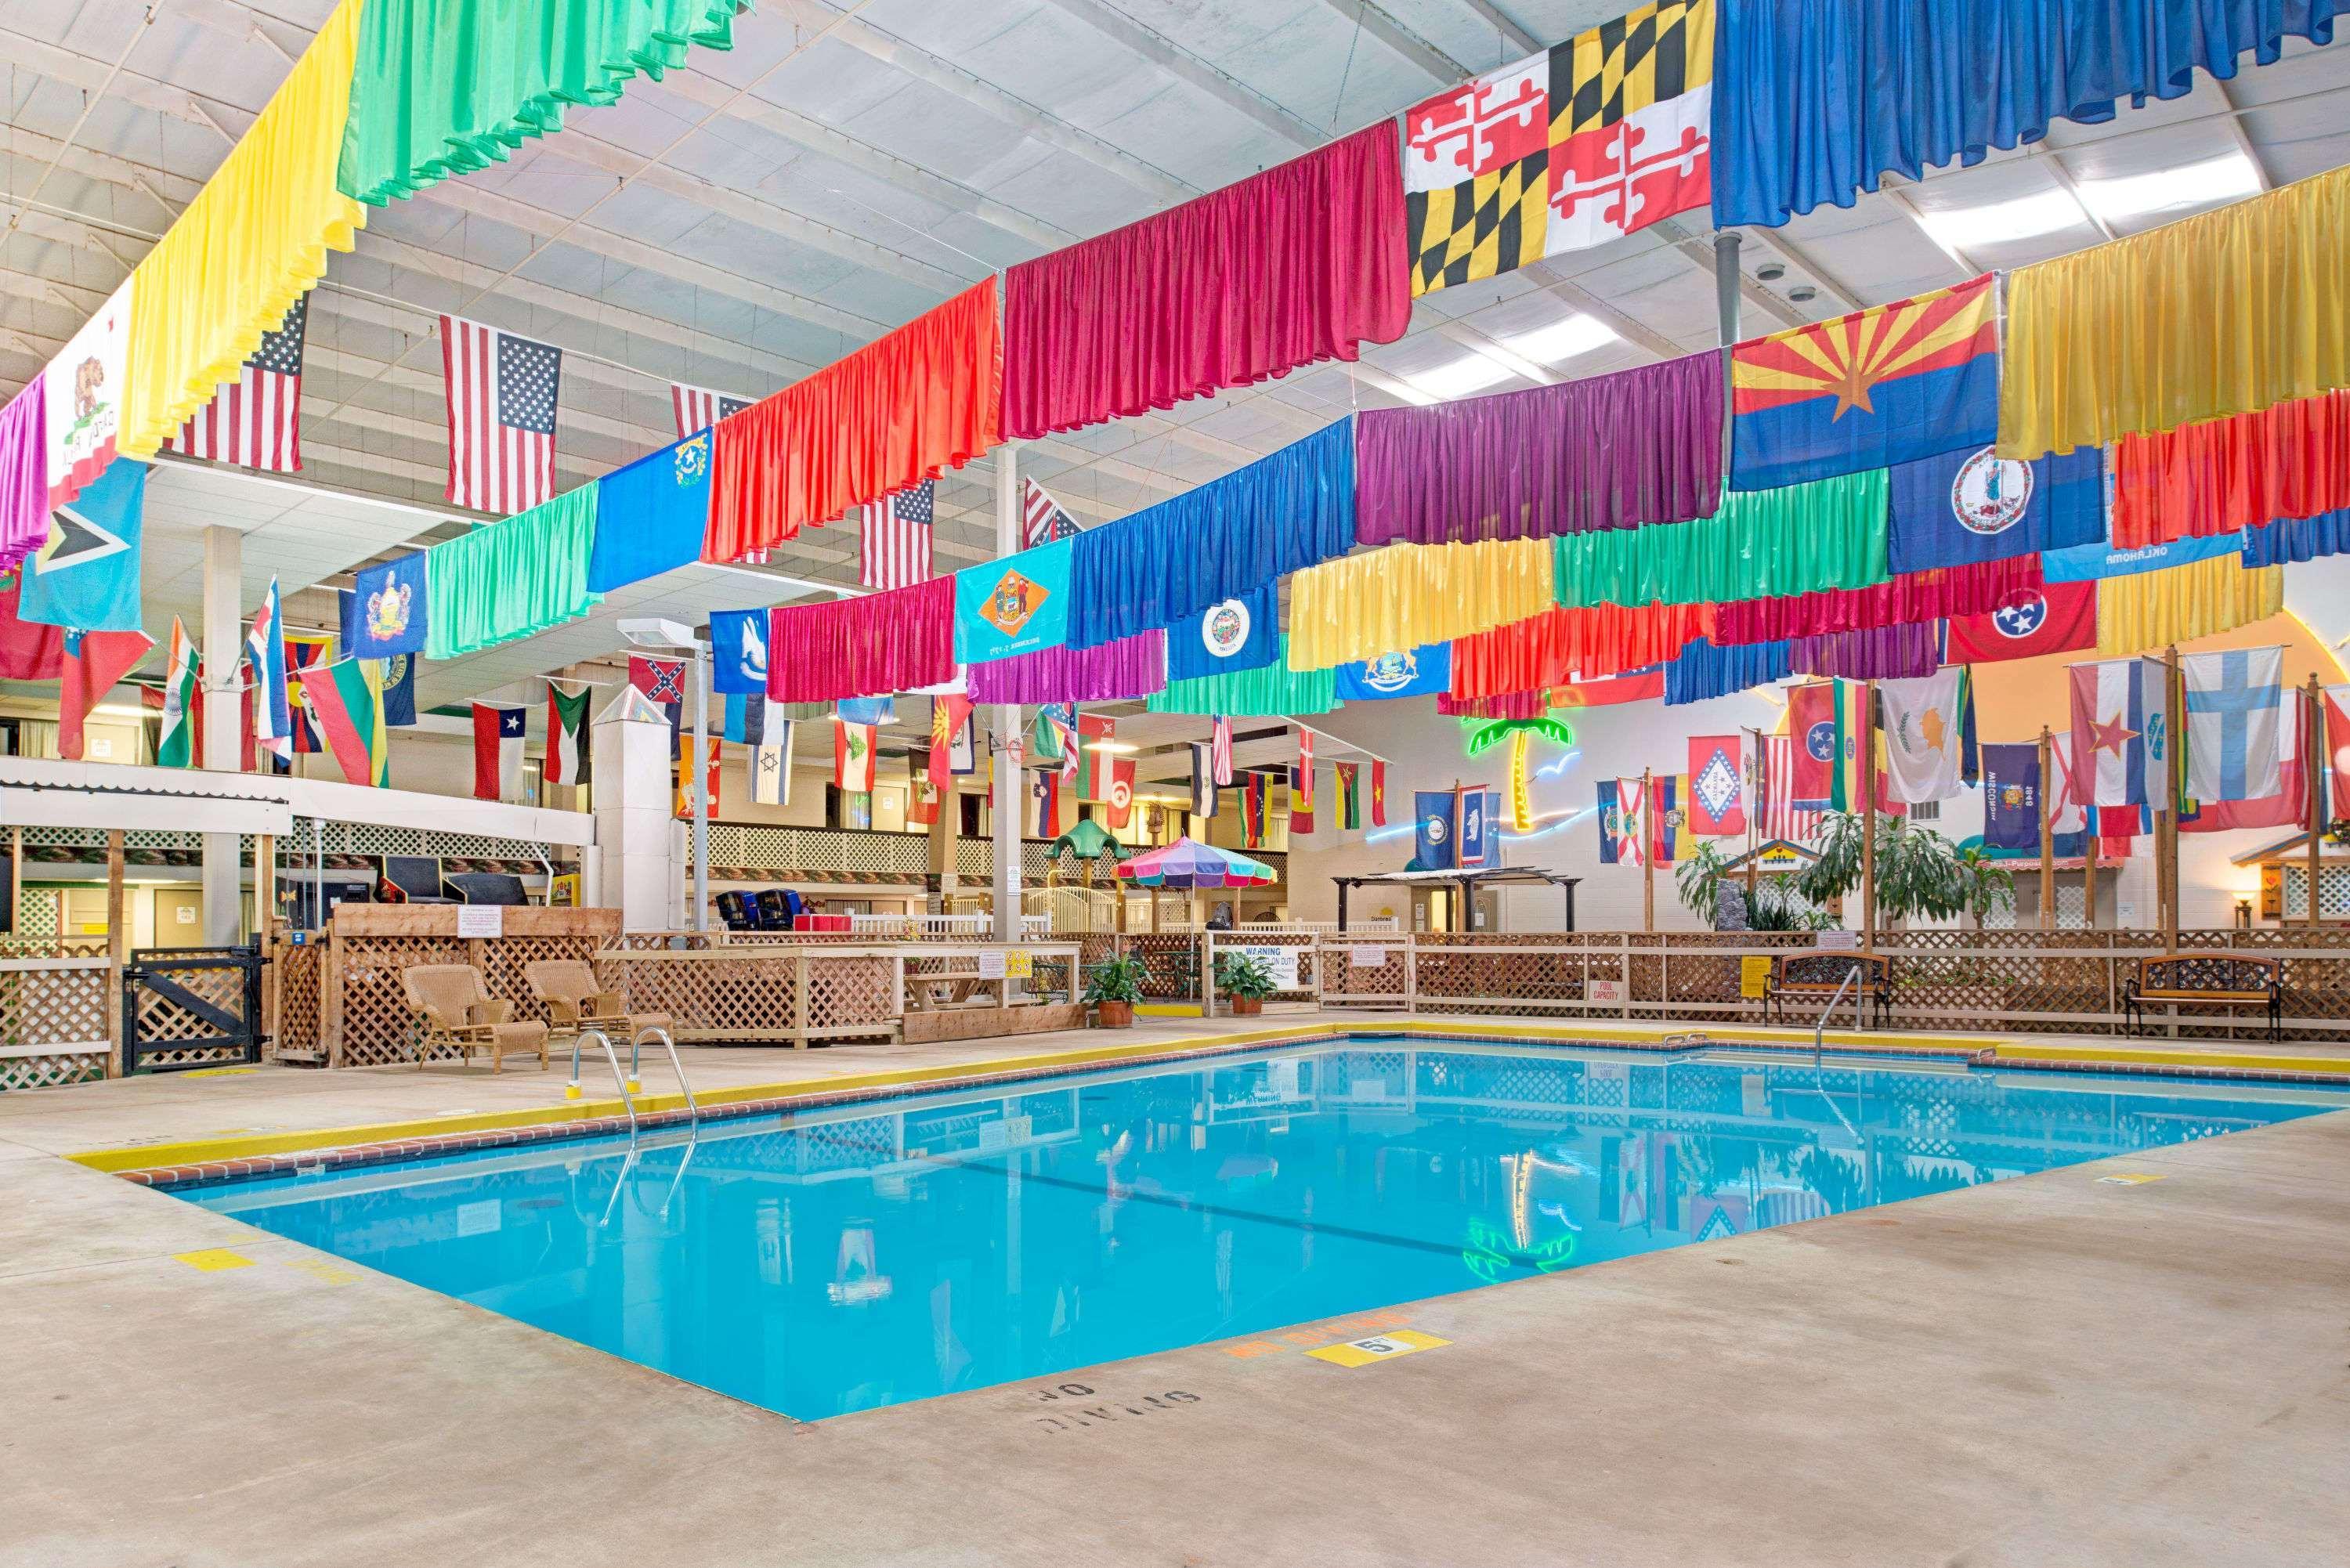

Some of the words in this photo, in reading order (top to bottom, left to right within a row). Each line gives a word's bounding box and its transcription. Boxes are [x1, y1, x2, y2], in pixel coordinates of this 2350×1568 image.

[1246, 947, 1281, 956] WARNING
[1282, 957, 1295, 966] DUTY
[1600, 981, 1612, 990] POOL
[1593, 990, 1618, 999] CAPACITY
[1354, 1340, 1394, 1353] 5
